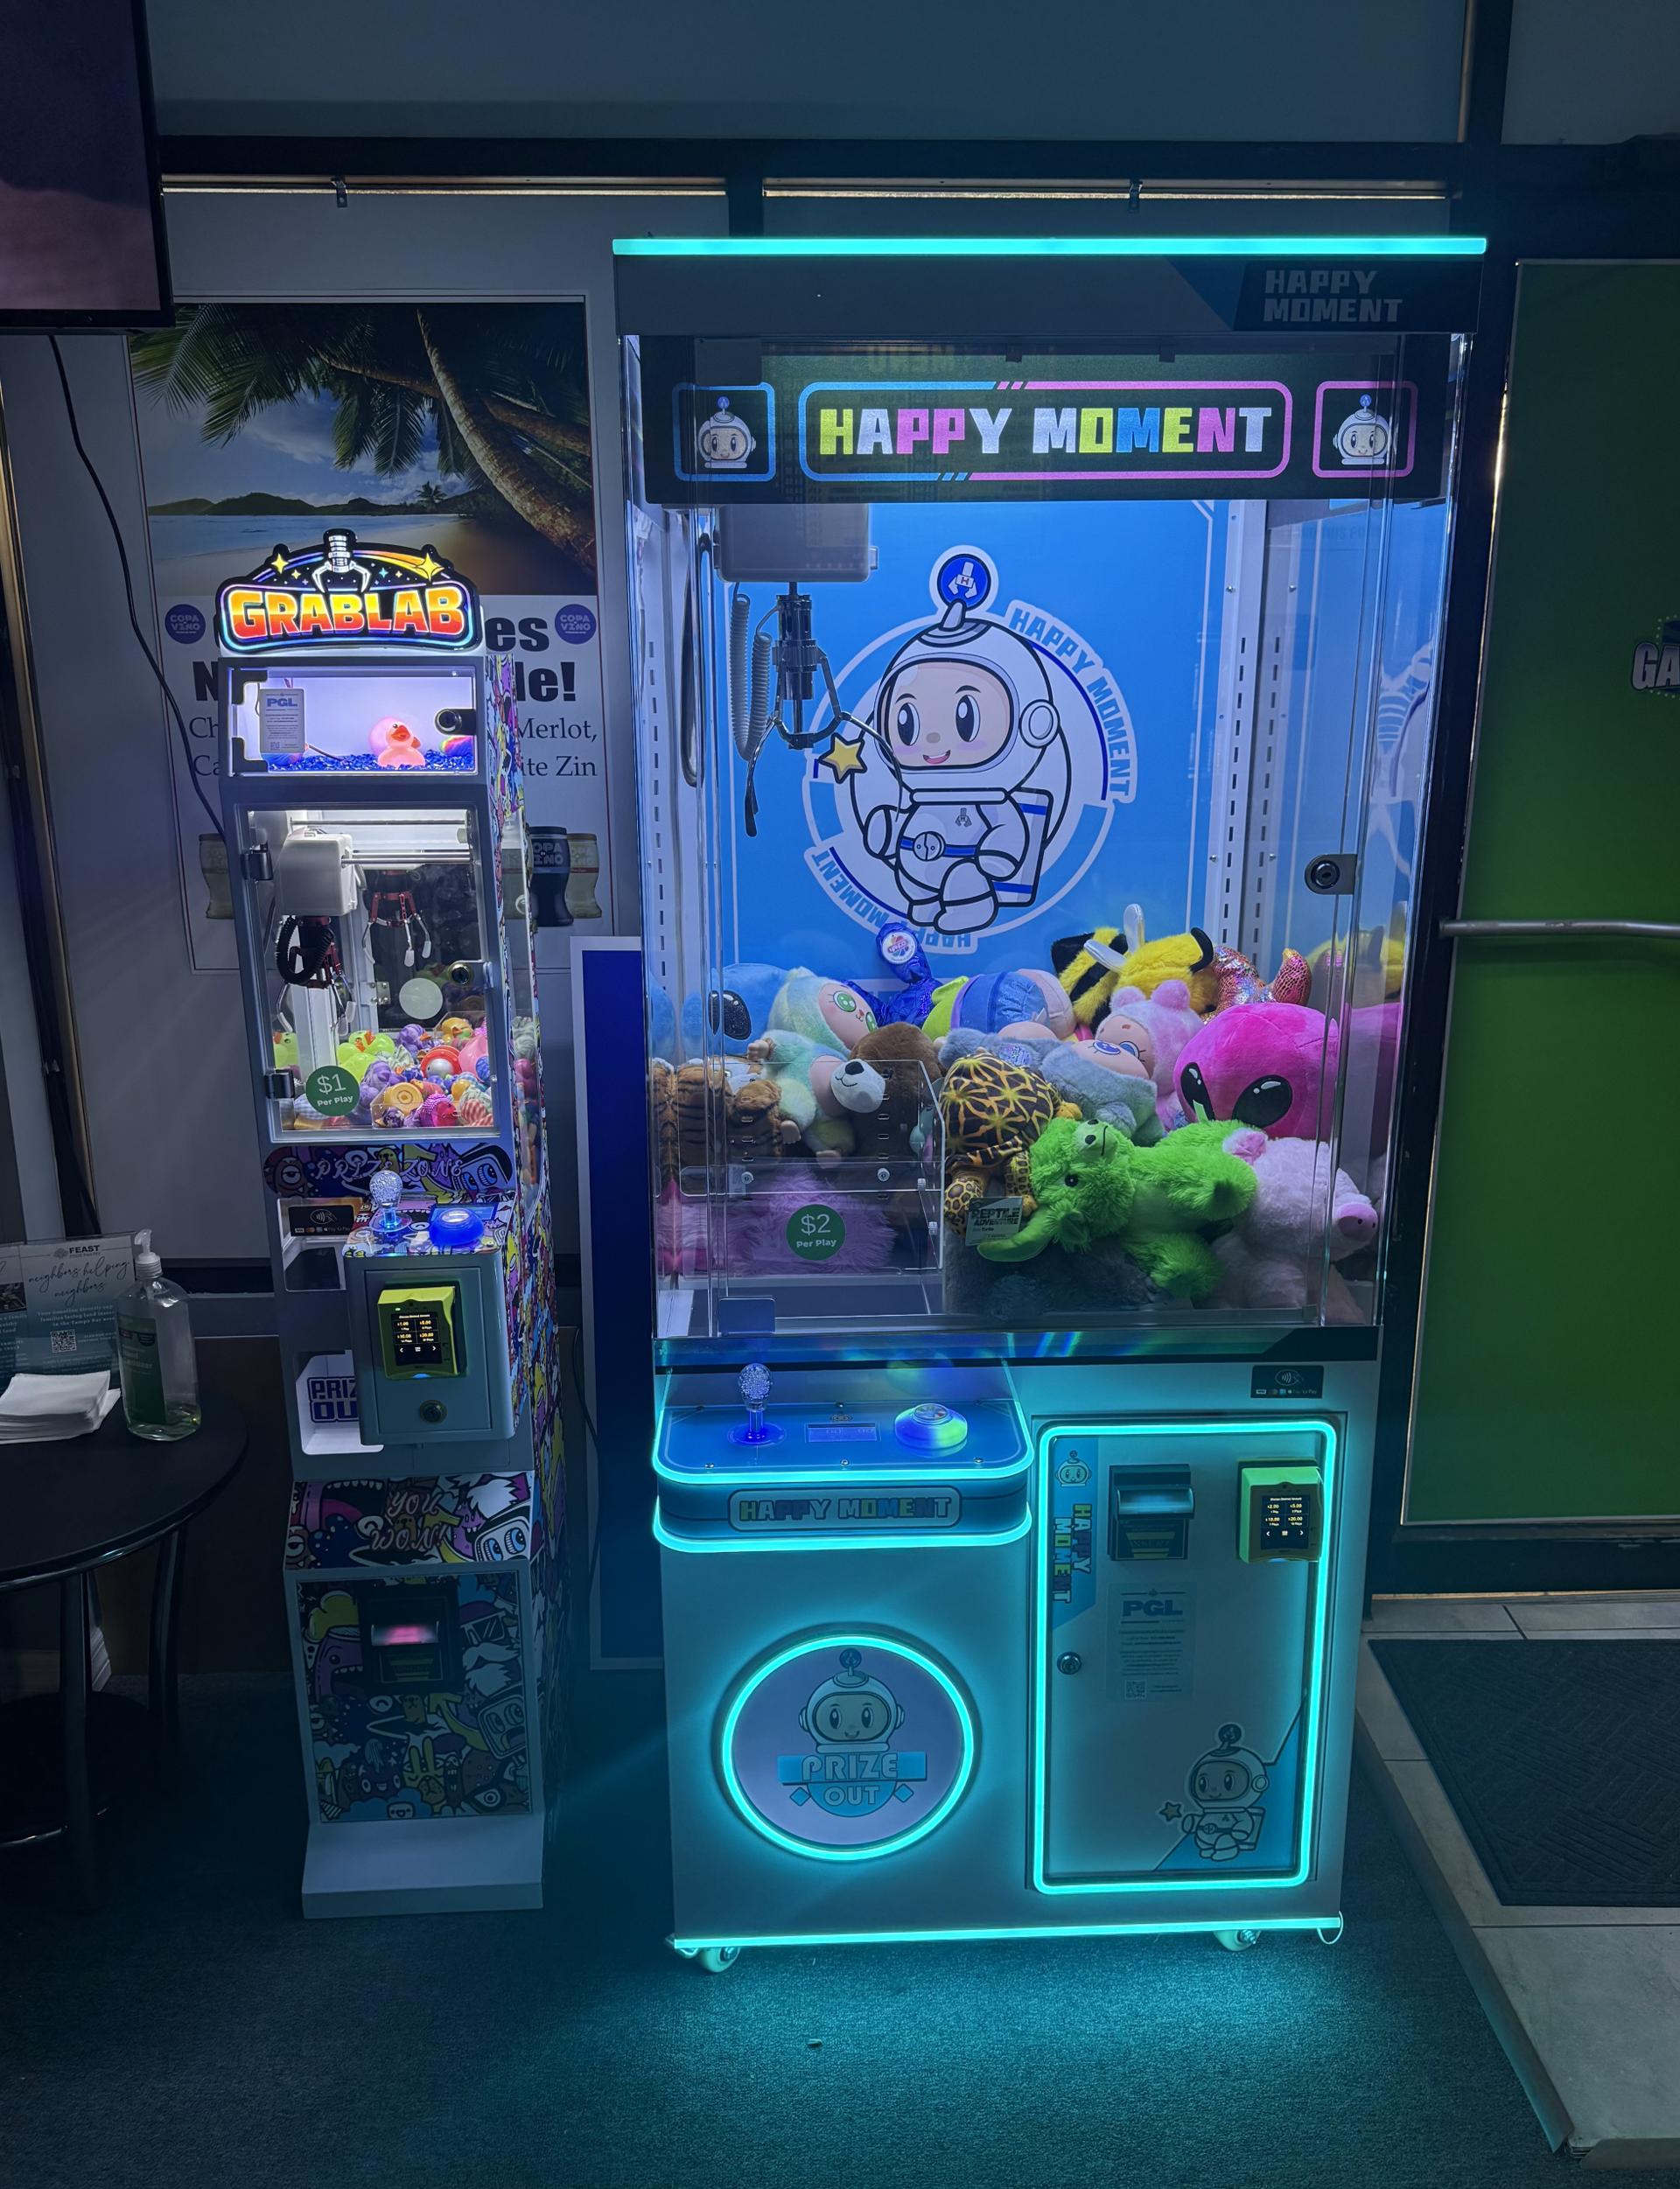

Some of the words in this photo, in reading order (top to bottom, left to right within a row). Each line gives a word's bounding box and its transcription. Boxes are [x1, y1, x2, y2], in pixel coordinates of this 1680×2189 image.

[1265, 269, 1378, 294] HAPPY
[1264, 298, 1403, 322] MOMENT
[820, 408, 1012, 454] HAPPY
[1032, 408, 1272, 453] MOMENT
[170, 614, 200, 623] COPA
[228, 585, 466, 640] GRABLAB
[560, 614, 590, 623] COPA
[485, 617, 550, 652] es
[561, 622, 592, 631] VINO
[1632, 642, 1680, 689] GA
[267, 698, 298, 707] PGL
[1009, 608, 1095, 675] HAPPY
[1087, 676, 1130, 796] MOMENT
[556, 755, 598, 777] Zin
[532, 843, 563, 852] OPA
[534, 855, 564, 864] INO
[812, 850, 890, 928] MOMENT
[317, 1074, 346, 1094] $1
[400, 1158, 463, 1178] ZONE
[971, 1207, 1020, 1219] REPTILE
[801, 1213, 831, 1236] $2
[69, 1244, 101, 1254] FEAST
[311, 1379, 357, 1399] PRIZ
[313, 1401, 358, 1419] OU
[387, 1491, 442, 1518] YOU
[740, 1499, 831, 1521] HAPPY
[838, 1497, 951, 1519] MOMENT
[371, 1523, 447, 1550] WON!
[1123, 1599, 1183, 1617] PGL
[802, 1752, 898, 1781] PRIZE
[823, 1785, 880, 1806] OUT
